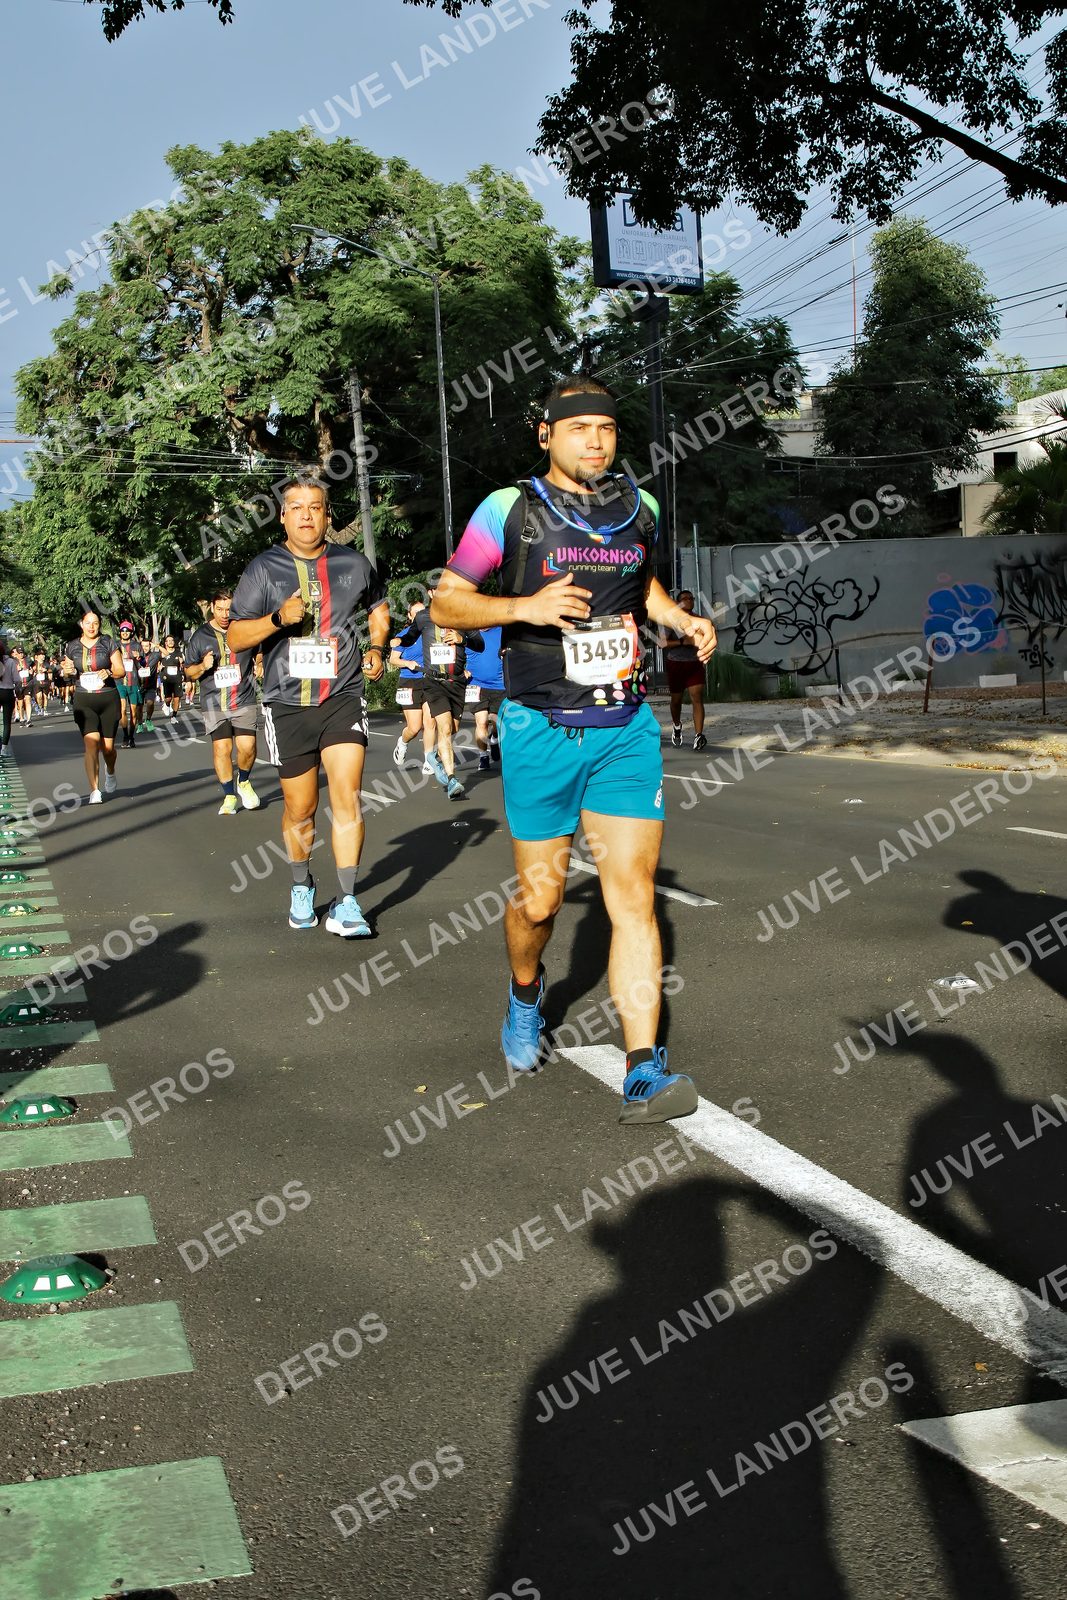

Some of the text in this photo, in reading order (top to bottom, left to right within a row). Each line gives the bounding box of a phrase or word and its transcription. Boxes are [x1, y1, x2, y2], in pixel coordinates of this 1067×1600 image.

[569, 564, 616, 572] running team
[569, 636, 630, 664] 13459
[292, 651, 332, 664] 13215
